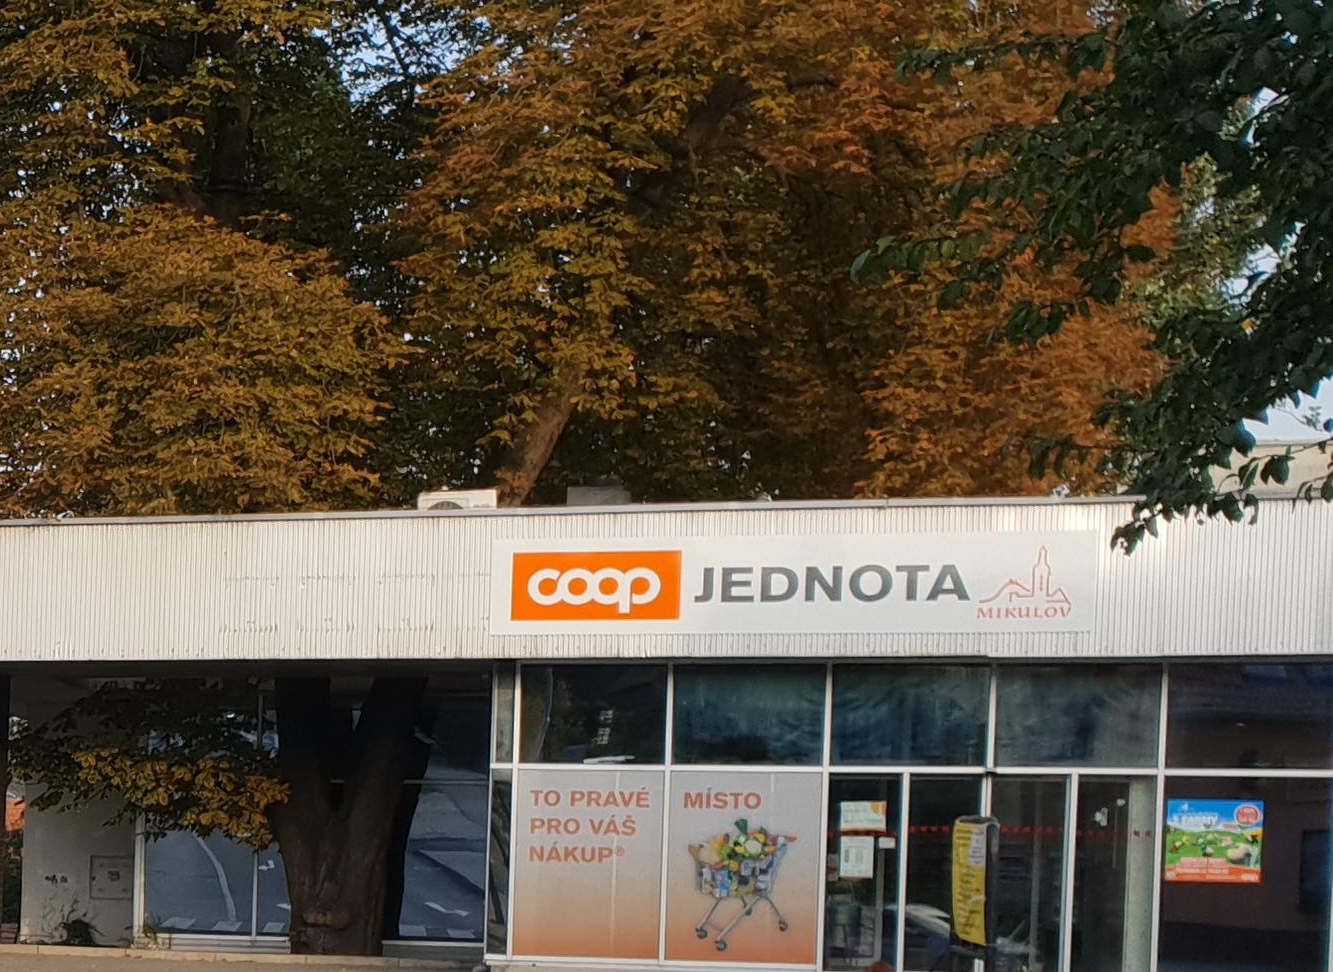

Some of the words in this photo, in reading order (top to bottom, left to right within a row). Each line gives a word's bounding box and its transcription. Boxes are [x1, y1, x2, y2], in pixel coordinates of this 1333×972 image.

[527, 567, 662, 614] coop
[694, 563, 972, 604] JEDNOTA
[976, 605, 1073, 620] MIKULOV
[530, 789, 561, 807] TO
[569, 786, 651, 809] PRAVÉ
[683, 787, 763, 810] MÍSTO
[529, 817, 581, 835] PRO
[589, 815, 637, 837] VÁŠ
